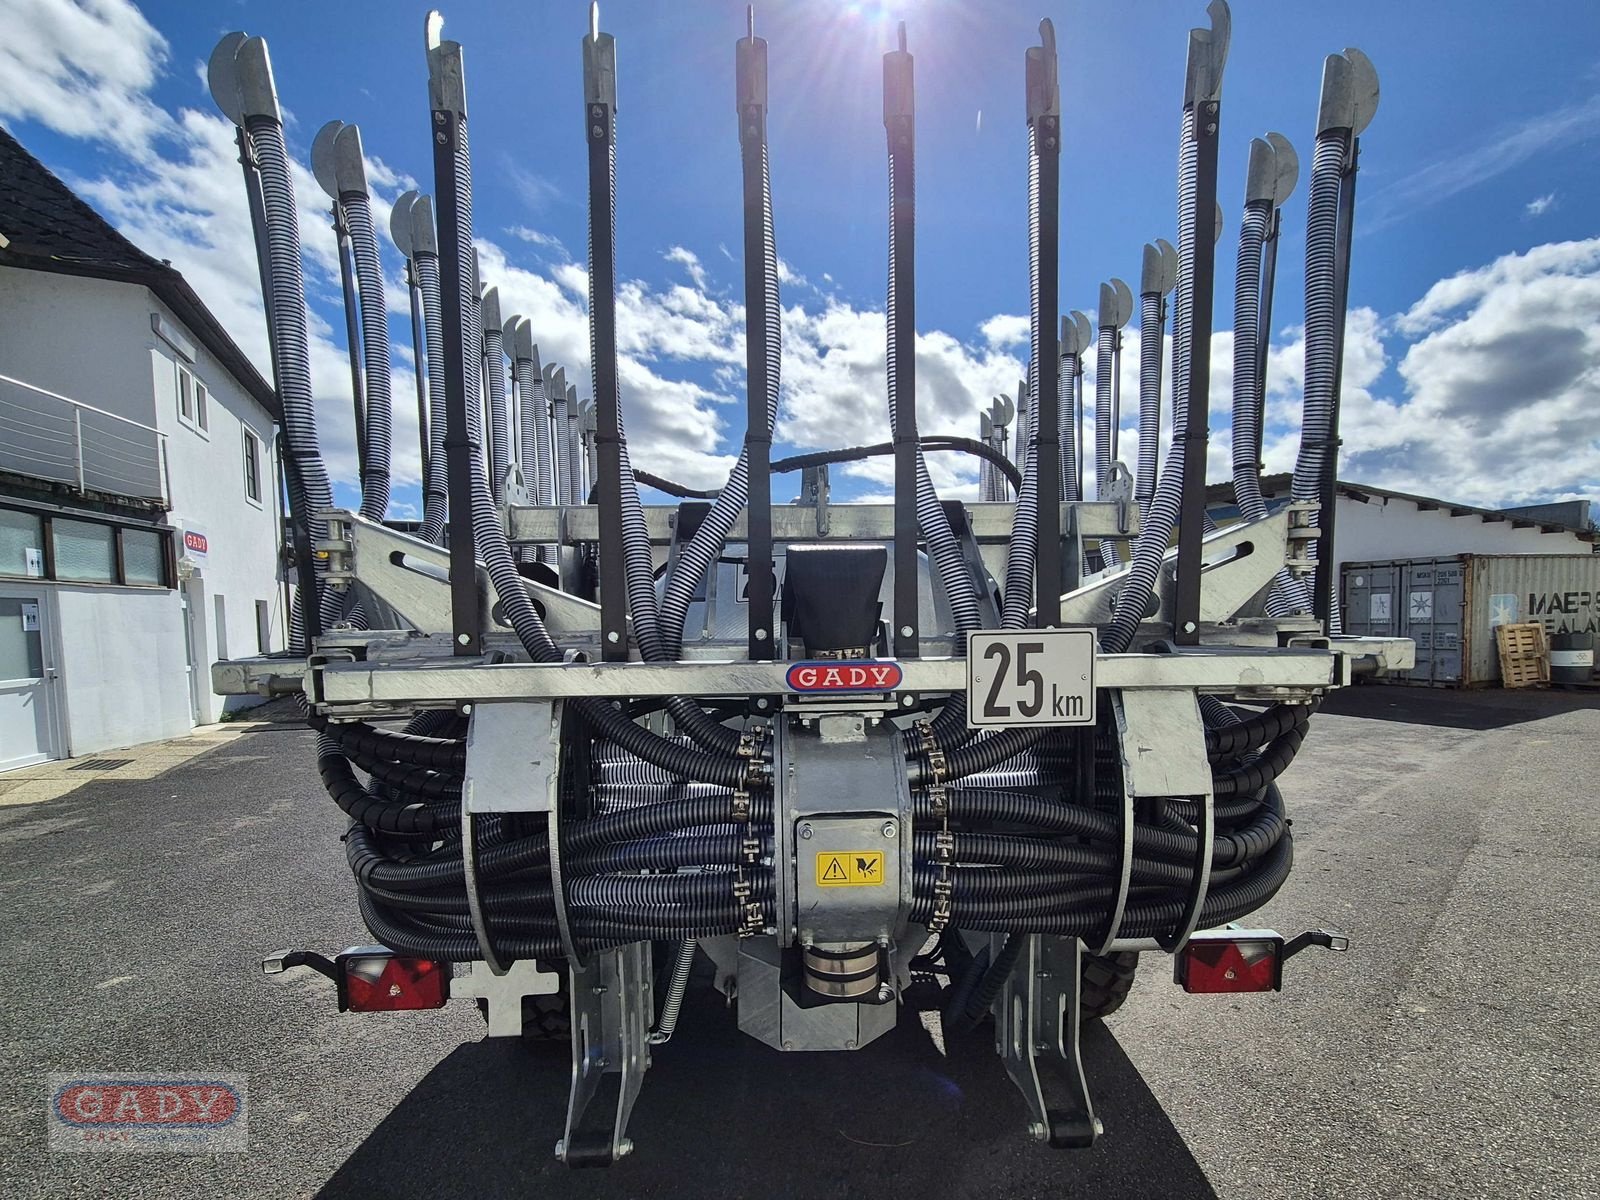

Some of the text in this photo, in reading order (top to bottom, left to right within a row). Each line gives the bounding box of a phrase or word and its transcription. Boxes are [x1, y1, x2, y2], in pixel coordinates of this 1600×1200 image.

[187, 534, 206, 550] GADY
[798, 667, 891, 687] GADY
[983, 642, 1083, 718] 25 km
